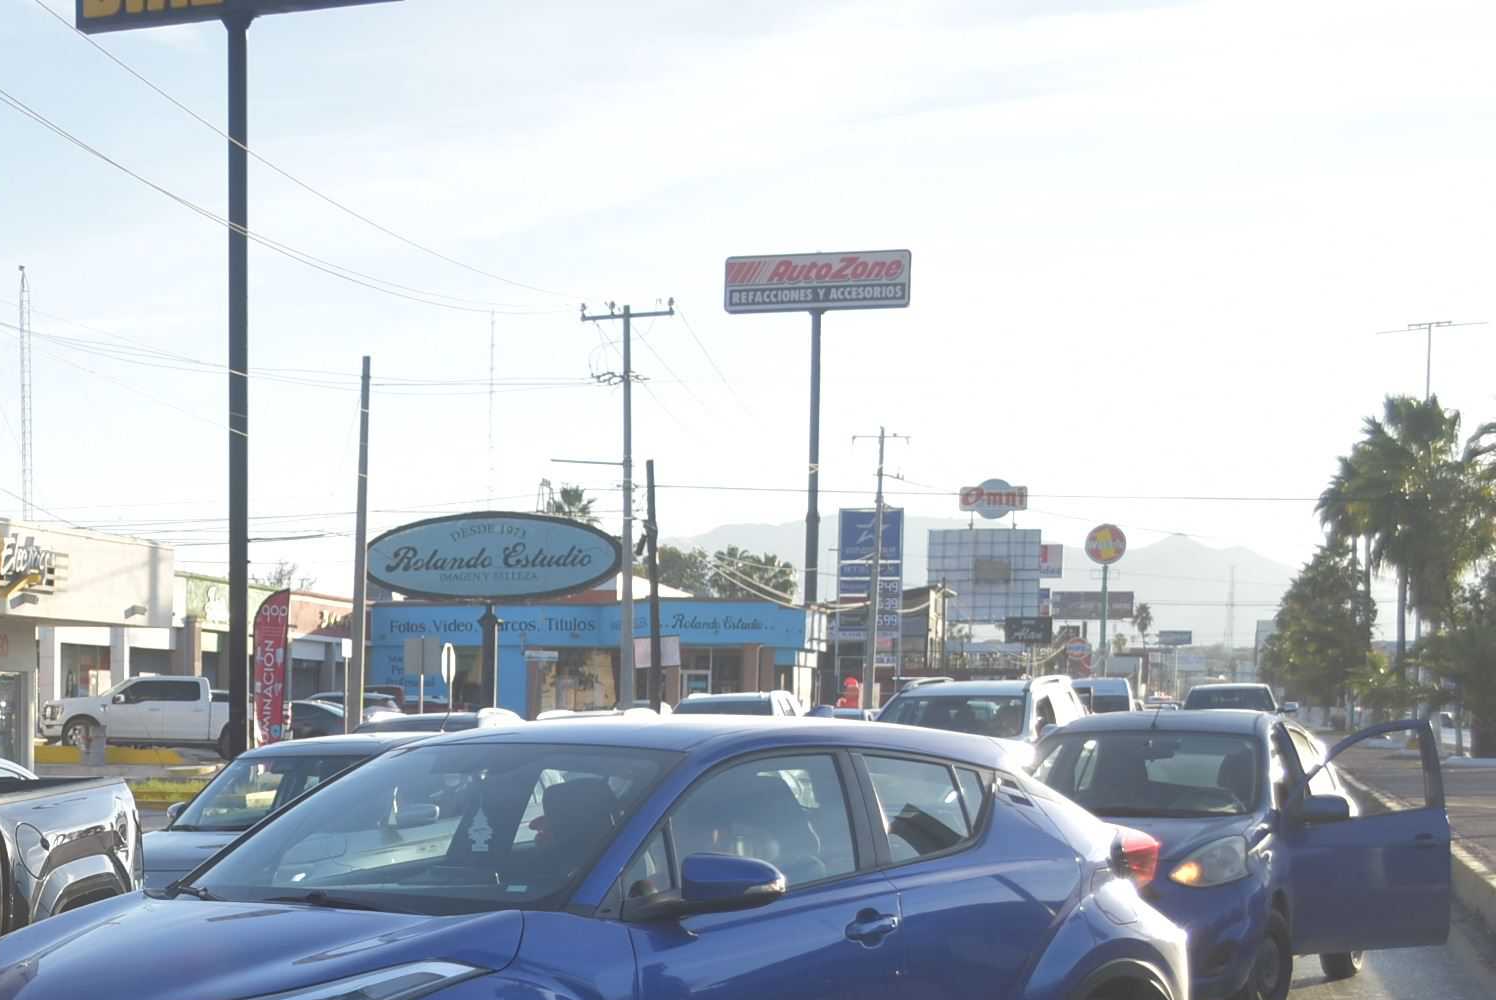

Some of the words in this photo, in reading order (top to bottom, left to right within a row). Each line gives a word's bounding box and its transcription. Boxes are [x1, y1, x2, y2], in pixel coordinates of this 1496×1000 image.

[769, 256, 901, 283] AutoZone
[731, 289, 813, 305] REFACCIONES
[817, 288, 826, 300] Y
[829, 285, 903, 300] ACCESORIOS
[450, 524, 494, 542] DESDE
[385, 546, 493, 573] Rolando
[503, 542, 592, 569] Estudio
